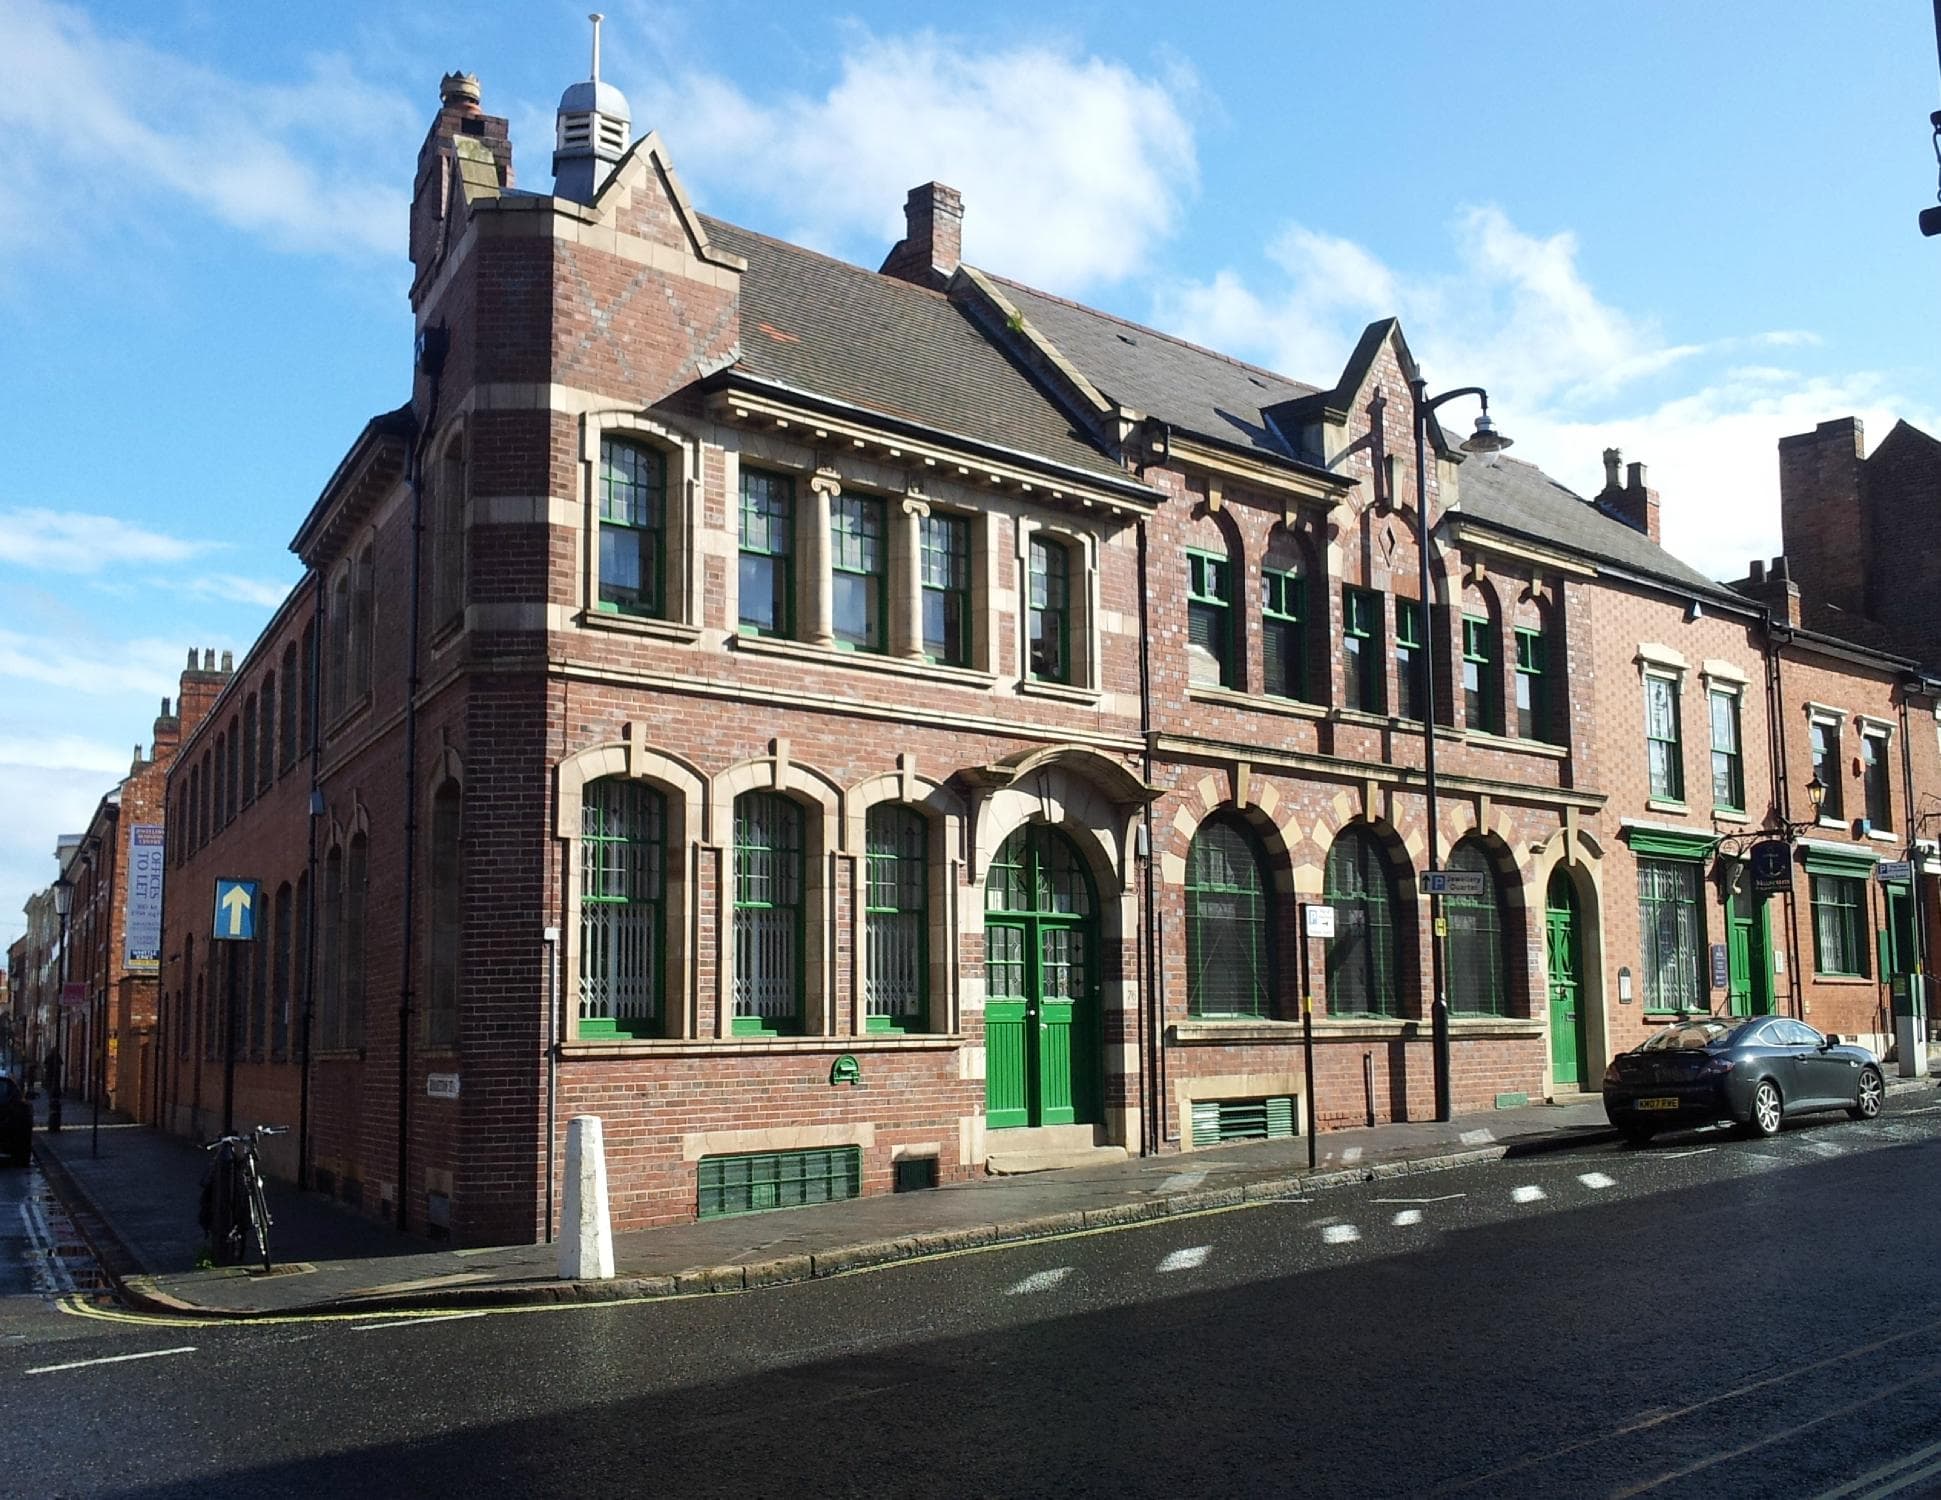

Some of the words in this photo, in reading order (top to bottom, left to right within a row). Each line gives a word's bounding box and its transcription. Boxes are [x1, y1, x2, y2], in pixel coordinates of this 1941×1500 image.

[137, 851, 149, 871] TO
[150, 851, 162, 899] OFFICES
[1435, 877, 1443, 889] P
[1447, 876, 1481, 884] Jewellery
[136, 874, 148, 899] LET
[1437, 920, 1446, 934] H
